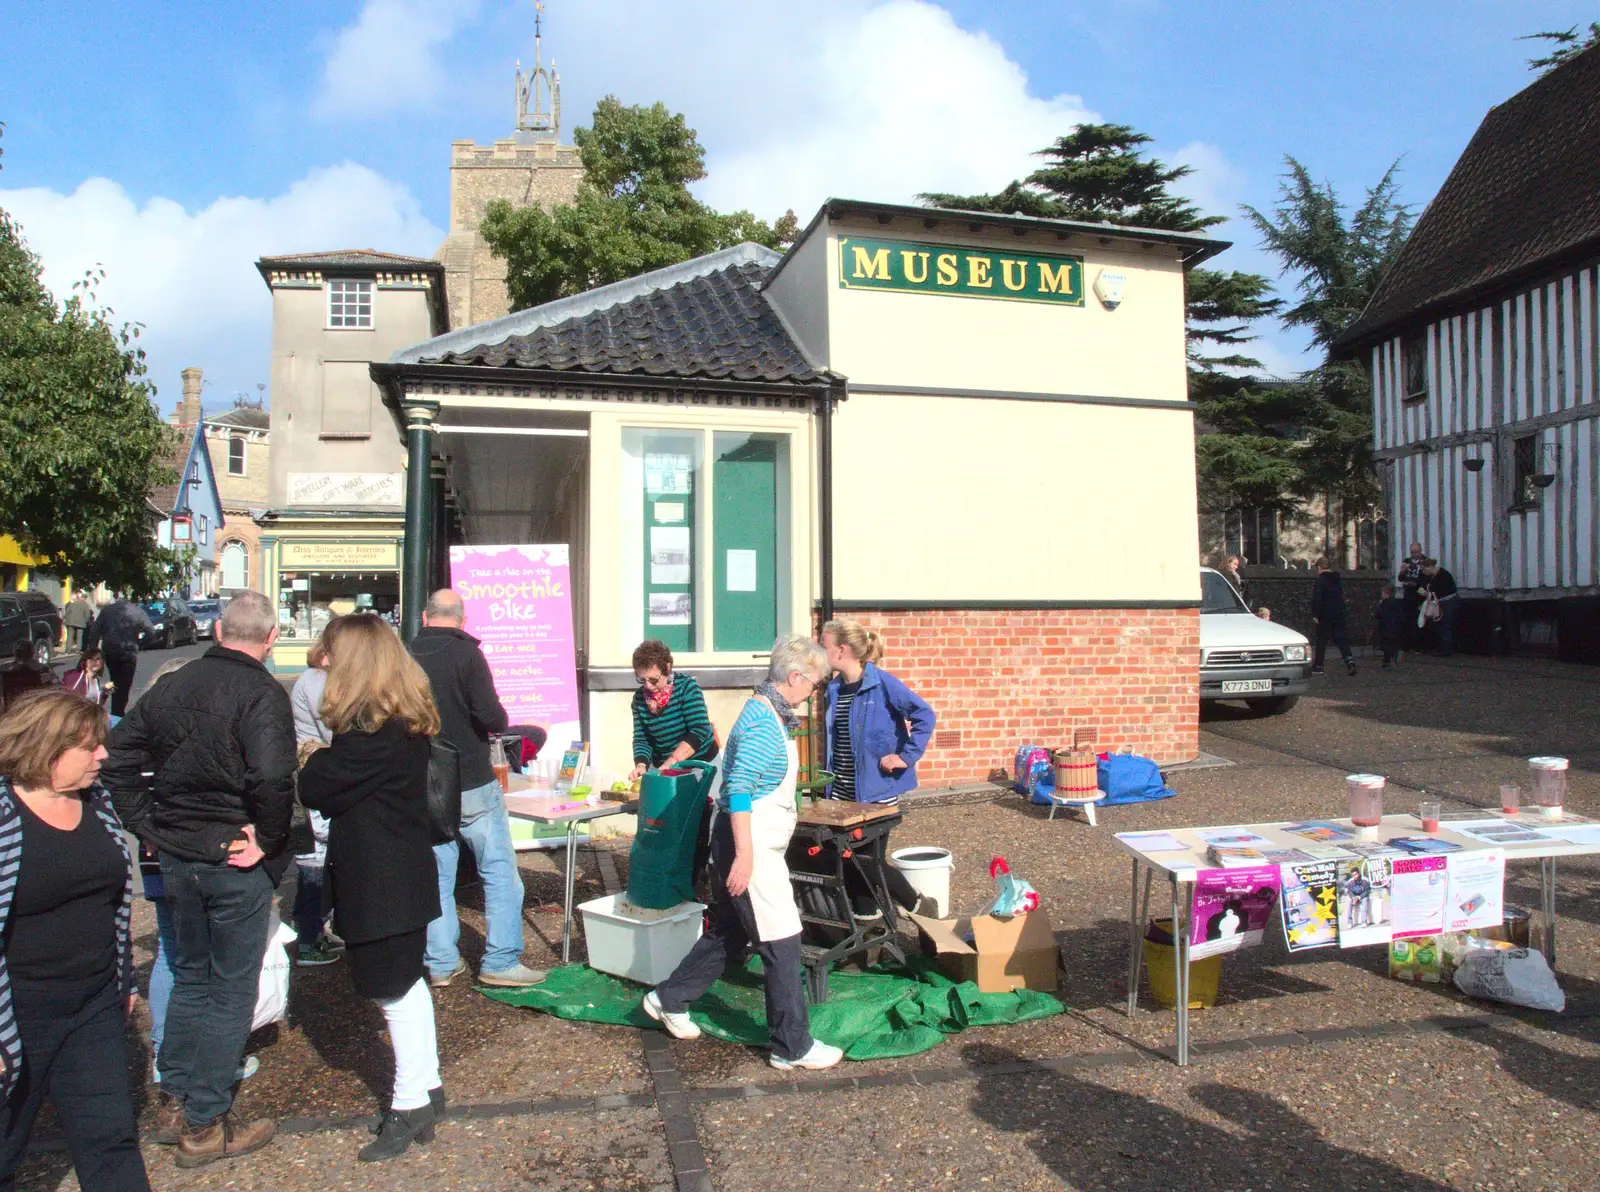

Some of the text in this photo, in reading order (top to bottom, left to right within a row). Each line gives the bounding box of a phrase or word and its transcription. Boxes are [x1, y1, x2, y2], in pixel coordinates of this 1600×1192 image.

[852, 247, 1074, 295] MUSEUM
[294, 476, 332, 500] JEWELLERY
[322, 476, 364, 500] GIFT WARE
[314, 545, 344, 554] Antiques
[469, 569, 492, 577] Take
[503, 567, 520, 576] ride
[535, 568, 552, 576] the
[457, 576, 564, 600] Smoothie
[489, 598, 537, 621] Bike
[495, 644, 536, 653] Eat well
[510, 665, 544, 676] active
[1223, 681, 1271, 691] X773 DNU
[1368, 858, 1387, 871] NINE
[1397, 859, 1422, 867] CORN
[789, 871, 824, 885] WORKMATE
[1299, 871, 1335, 882] Comedy
[1369, 870, 1388, 883] LIVES
